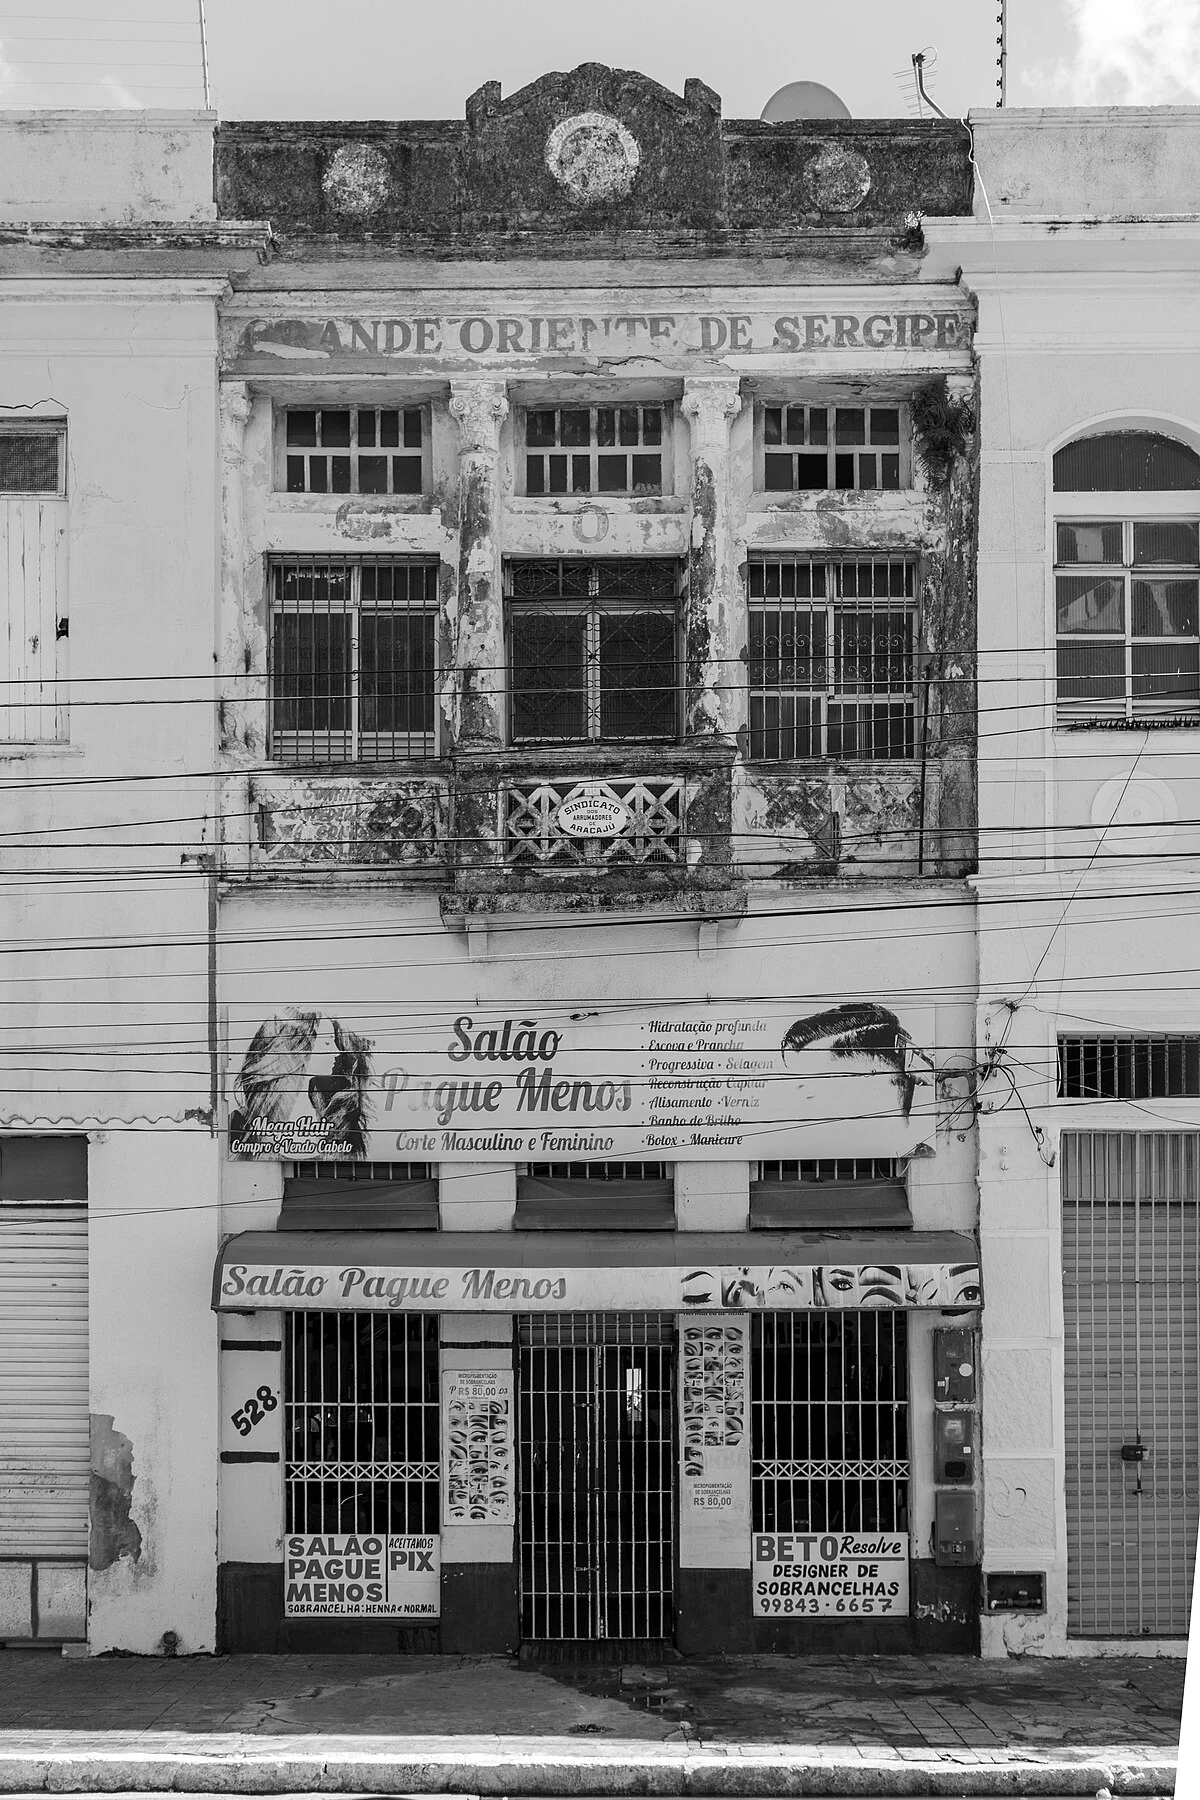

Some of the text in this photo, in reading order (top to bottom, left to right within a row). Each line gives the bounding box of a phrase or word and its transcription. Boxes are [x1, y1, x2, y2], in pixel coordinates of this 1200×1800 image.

[699, 316, 753, 349] DE
[773, 313, 962, 350] SERGIPE
[564, 800, 621, 815] SINDICATO
[648, 1020, 767, 1035] Hidratação profunda
[447, 1016, 563, 1062] Salão
[649, 1038, 744, 1051] Escova e Prancha
[649, 1057, 774, 1074] Progressiva Selagem
[516, 1066, 632, 1112] Menos
[649, 1077, 723, 1092] Reconstrução
[649, 1095, 760, 1109] Alisamento Verniz
[251, 1115, 334, 1141] Mega Hair
[649, 1114, 742, 1126] Banho de Brilho
[231, 1139, 354, 1156] Compro e Vendo Cabelo
[395, 1131, 614, 1151] Corte Masculino e Feminino
[646, 1133, 743, 1146] Botox Manicure
[222, 1265, 567, 1307] Salão Pague Menos
[458, 1387, 470, 1396] R$
[472, 1387, 496, 1397] 80,00
[231, 1385, 278, 1436] 528
[707, 1497, 732, 1507] 80,00
[288, 1535, 383, 1557] SALÃO
[388, 1537, 434, 1549] ACEITAMOS
[756, 1535, 902, 1562] BETO Resolve
[390, 1550, 435, 1571] PIX
[288, 1559, 381, 1580] PAGUE
[773, 1564, 879, 1578] DESIGNER DE
[286, 1583, 383, 1602] MENOS
[757, 1581, 900, 1596] SOBRANCELHAS
[403, 1604, 437, 1613] NORMAL
